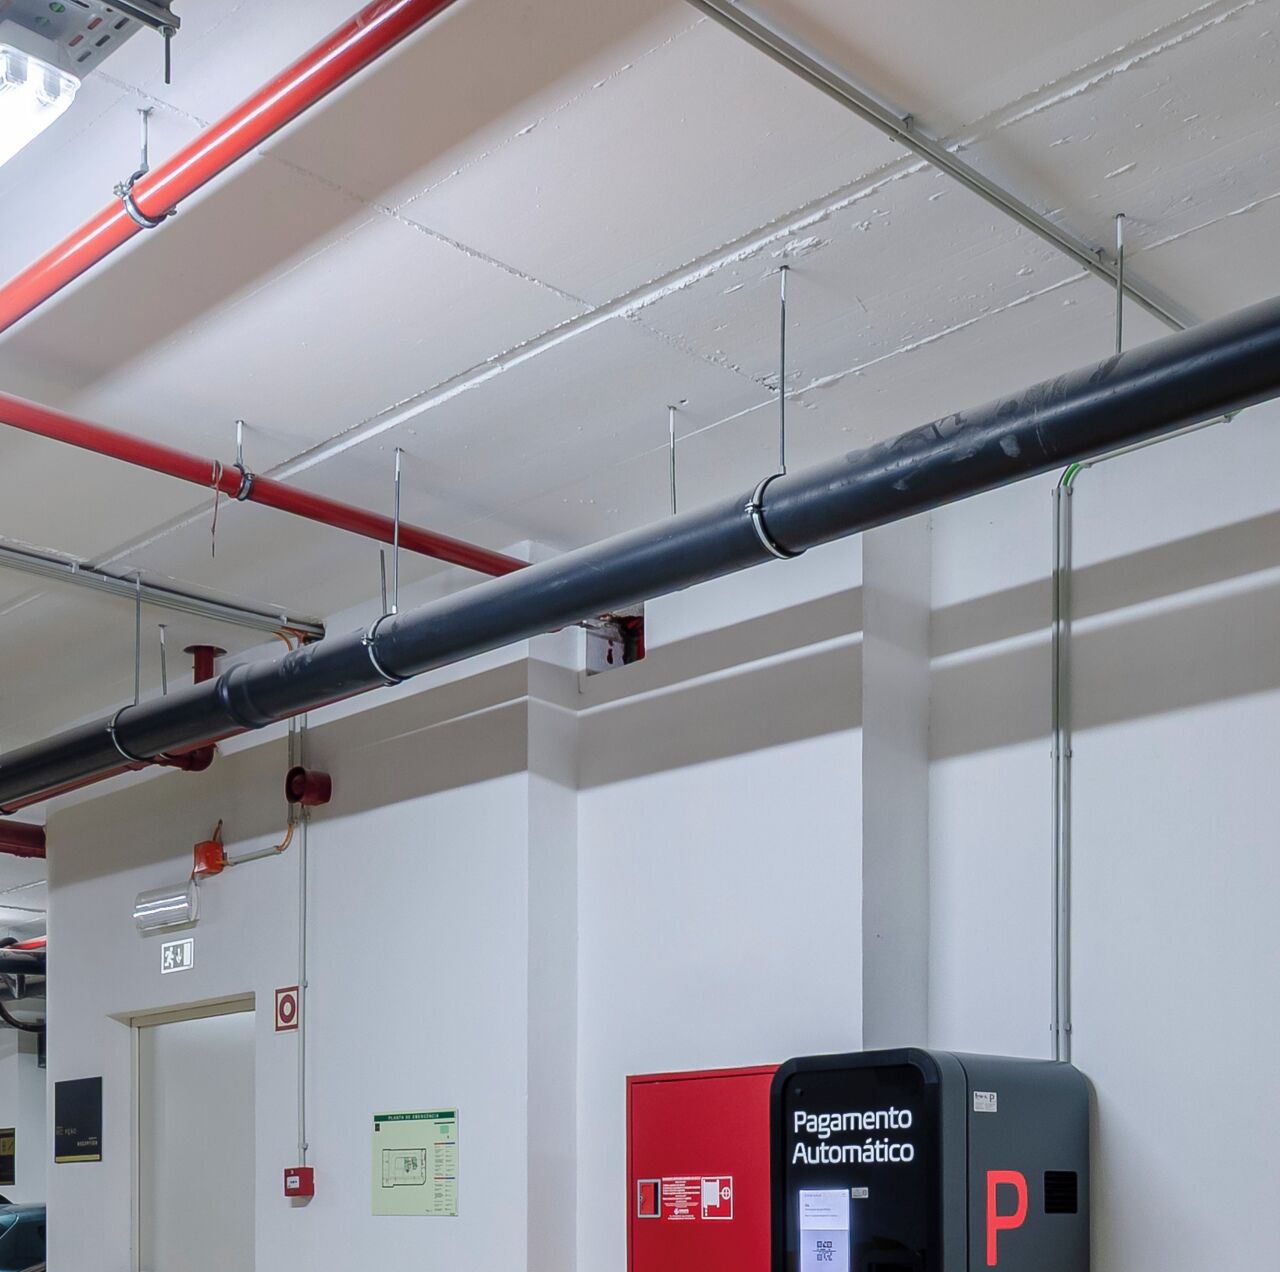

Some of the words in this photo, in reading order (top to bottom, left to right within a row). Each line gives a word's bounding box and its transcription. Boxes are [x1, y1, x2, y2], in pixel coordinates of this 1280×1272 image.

[793, 1106, 913, 1139] Pagamento
[792, 1138, 915, 1164] Automático
[986, 1170, 1028, 1267] P
